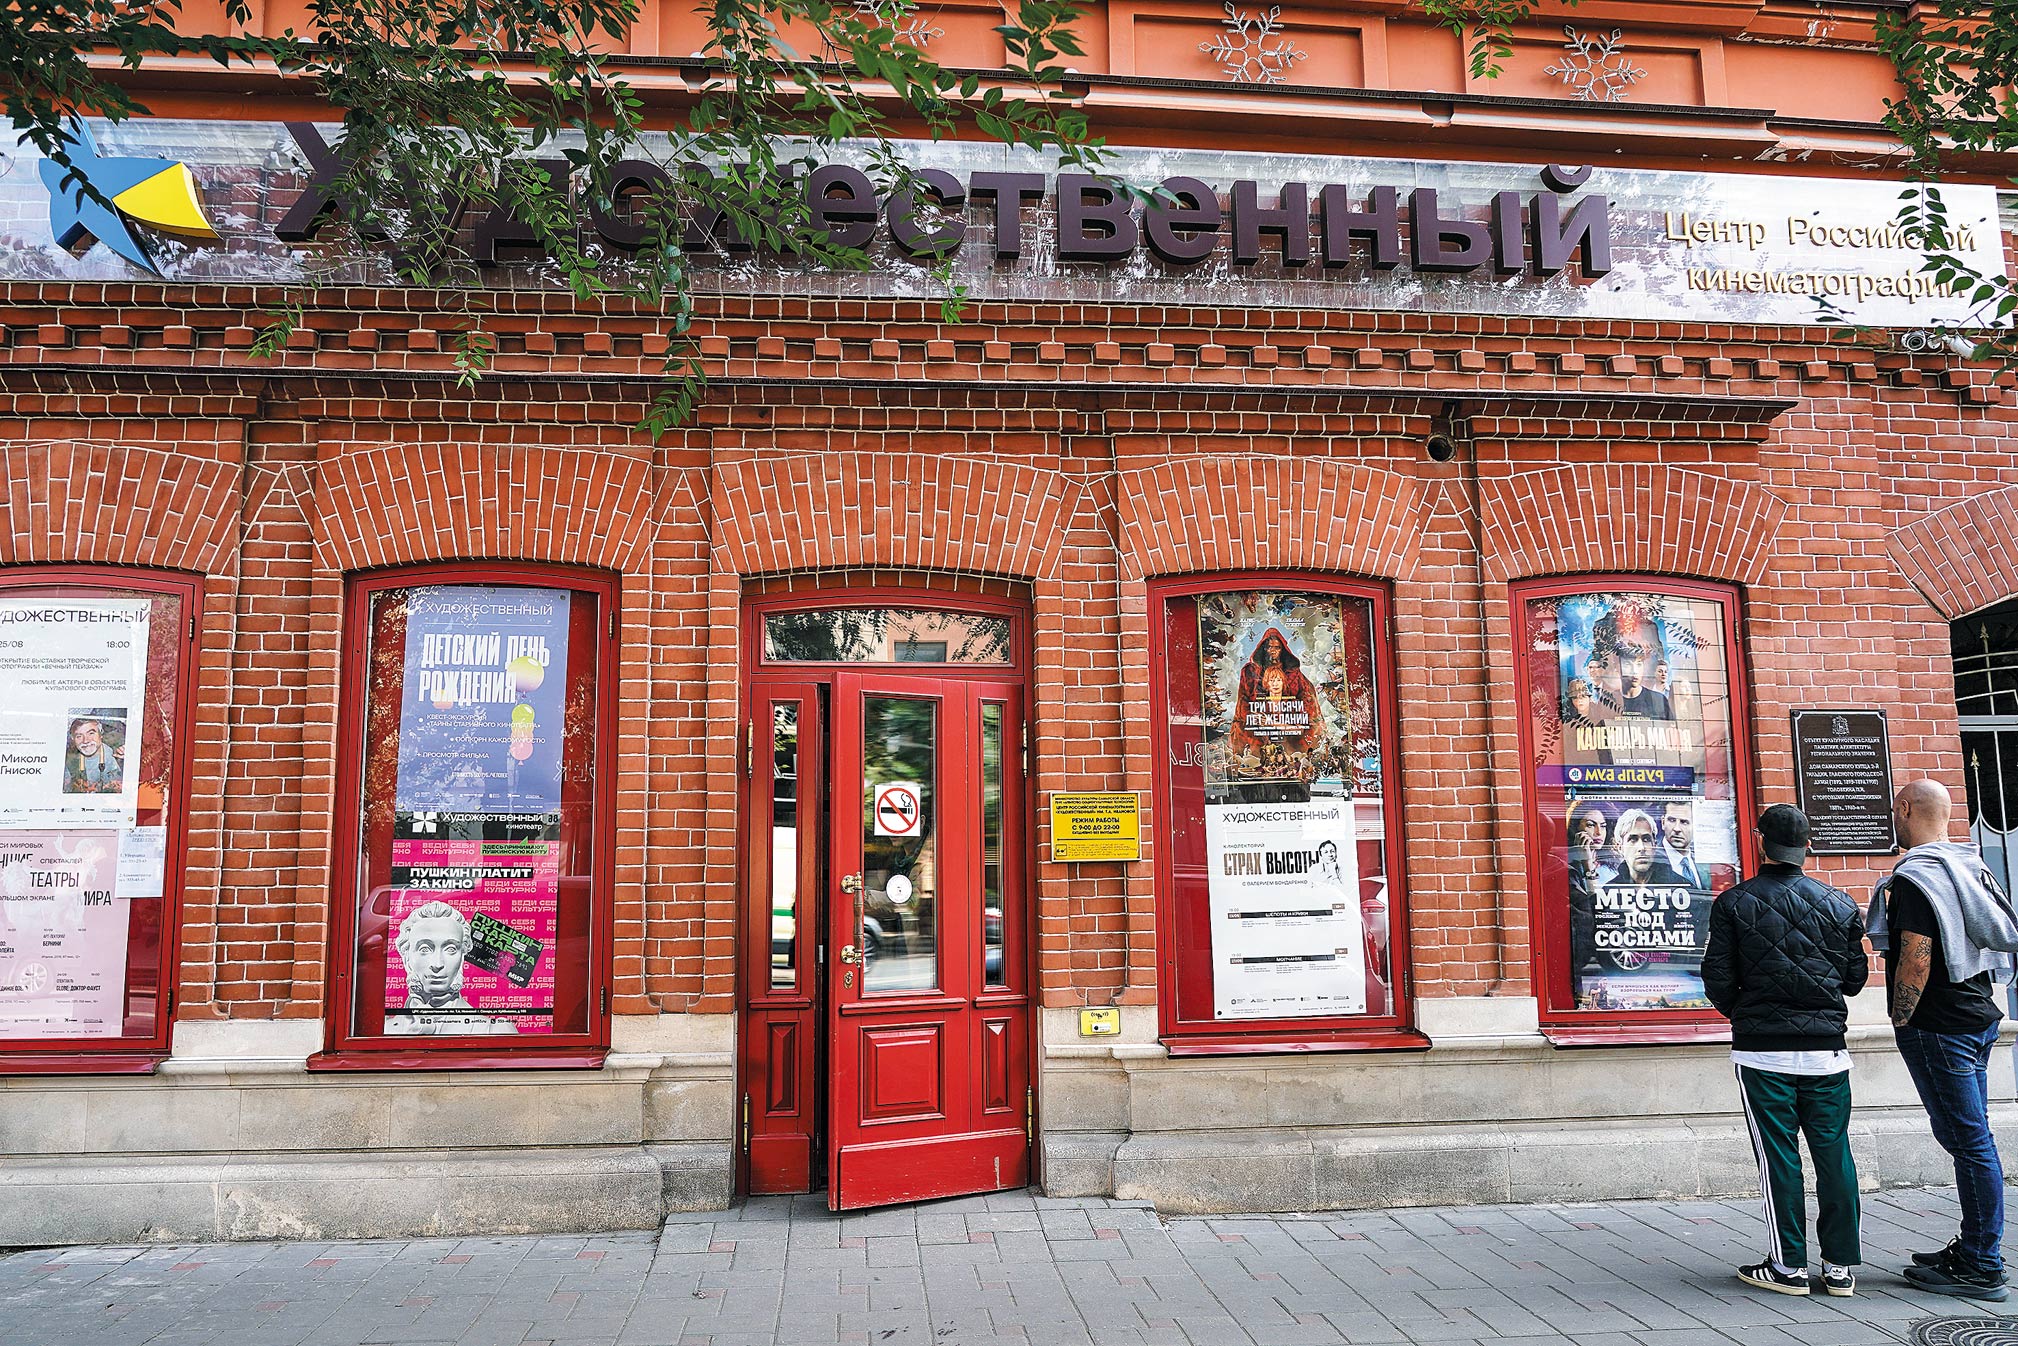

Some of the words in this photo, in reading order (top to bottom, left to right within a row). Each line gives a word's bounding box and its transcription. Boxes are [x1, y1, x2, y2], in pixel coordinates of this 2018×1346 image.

[1666, 211, 1768, 250] Центр
[1788, 215, 1977, 252] Российсой
[0, 605, 150, 624] ДОЖЕСТВЕННЫЙ
[426, 602, 553, 616] ХУДОЖЕСТВЕННЫЙ
[421, 632, 500, 668] ДЕТСКИЙ
[504, 636, 550, 668] ДЕНЬ
[418, 670, 516, 706] РОЖДЕНИЯ
[1249, 702, 1266, 712] ТРИ
[1268, 700, 1304, 712] ТЫСЯЧИ
[1246, 714, 1262, 726] ЛЕТ
[1265, 712, 1308, 724] ЖЕЛАНИЙ
[1576, 726, 1646, 751] КАЛЕНДАРЬ
[2, 754, 48, 763] Микола
[0, 766, 42, 774] Гнисюк
[443, 812, 543, 824] Художественный
[1222, 808, 1340, 824] ХУДОЖЕСТВЕННЫЙ
[1224, 852, 1262, 876] СТРАХ
[1266, 850, 1320, 875] ВЫСОТЫ
[30, 872, 80, 888] ТЕАТРЫ
[410, 868, 471, 878] ПУШКИН
[472, 868, 532, 878] ПЛАТИТ
[410, 879, 430, 888] ЗА
[432, 879, 473, 888] КИНО
[1594, 888, 1690, 910] МЕСТО
[1624, 912, 1666, 930] ПОД
[471, 920, 513, 946] СКАЯ
[475, 912, 544, 951] ПУШКИН
[1594, 930, 1696, 946] СОСНАМИ
[485, 936, 534, 966] КАРТА
[508, 972, 524, 982] МИР
